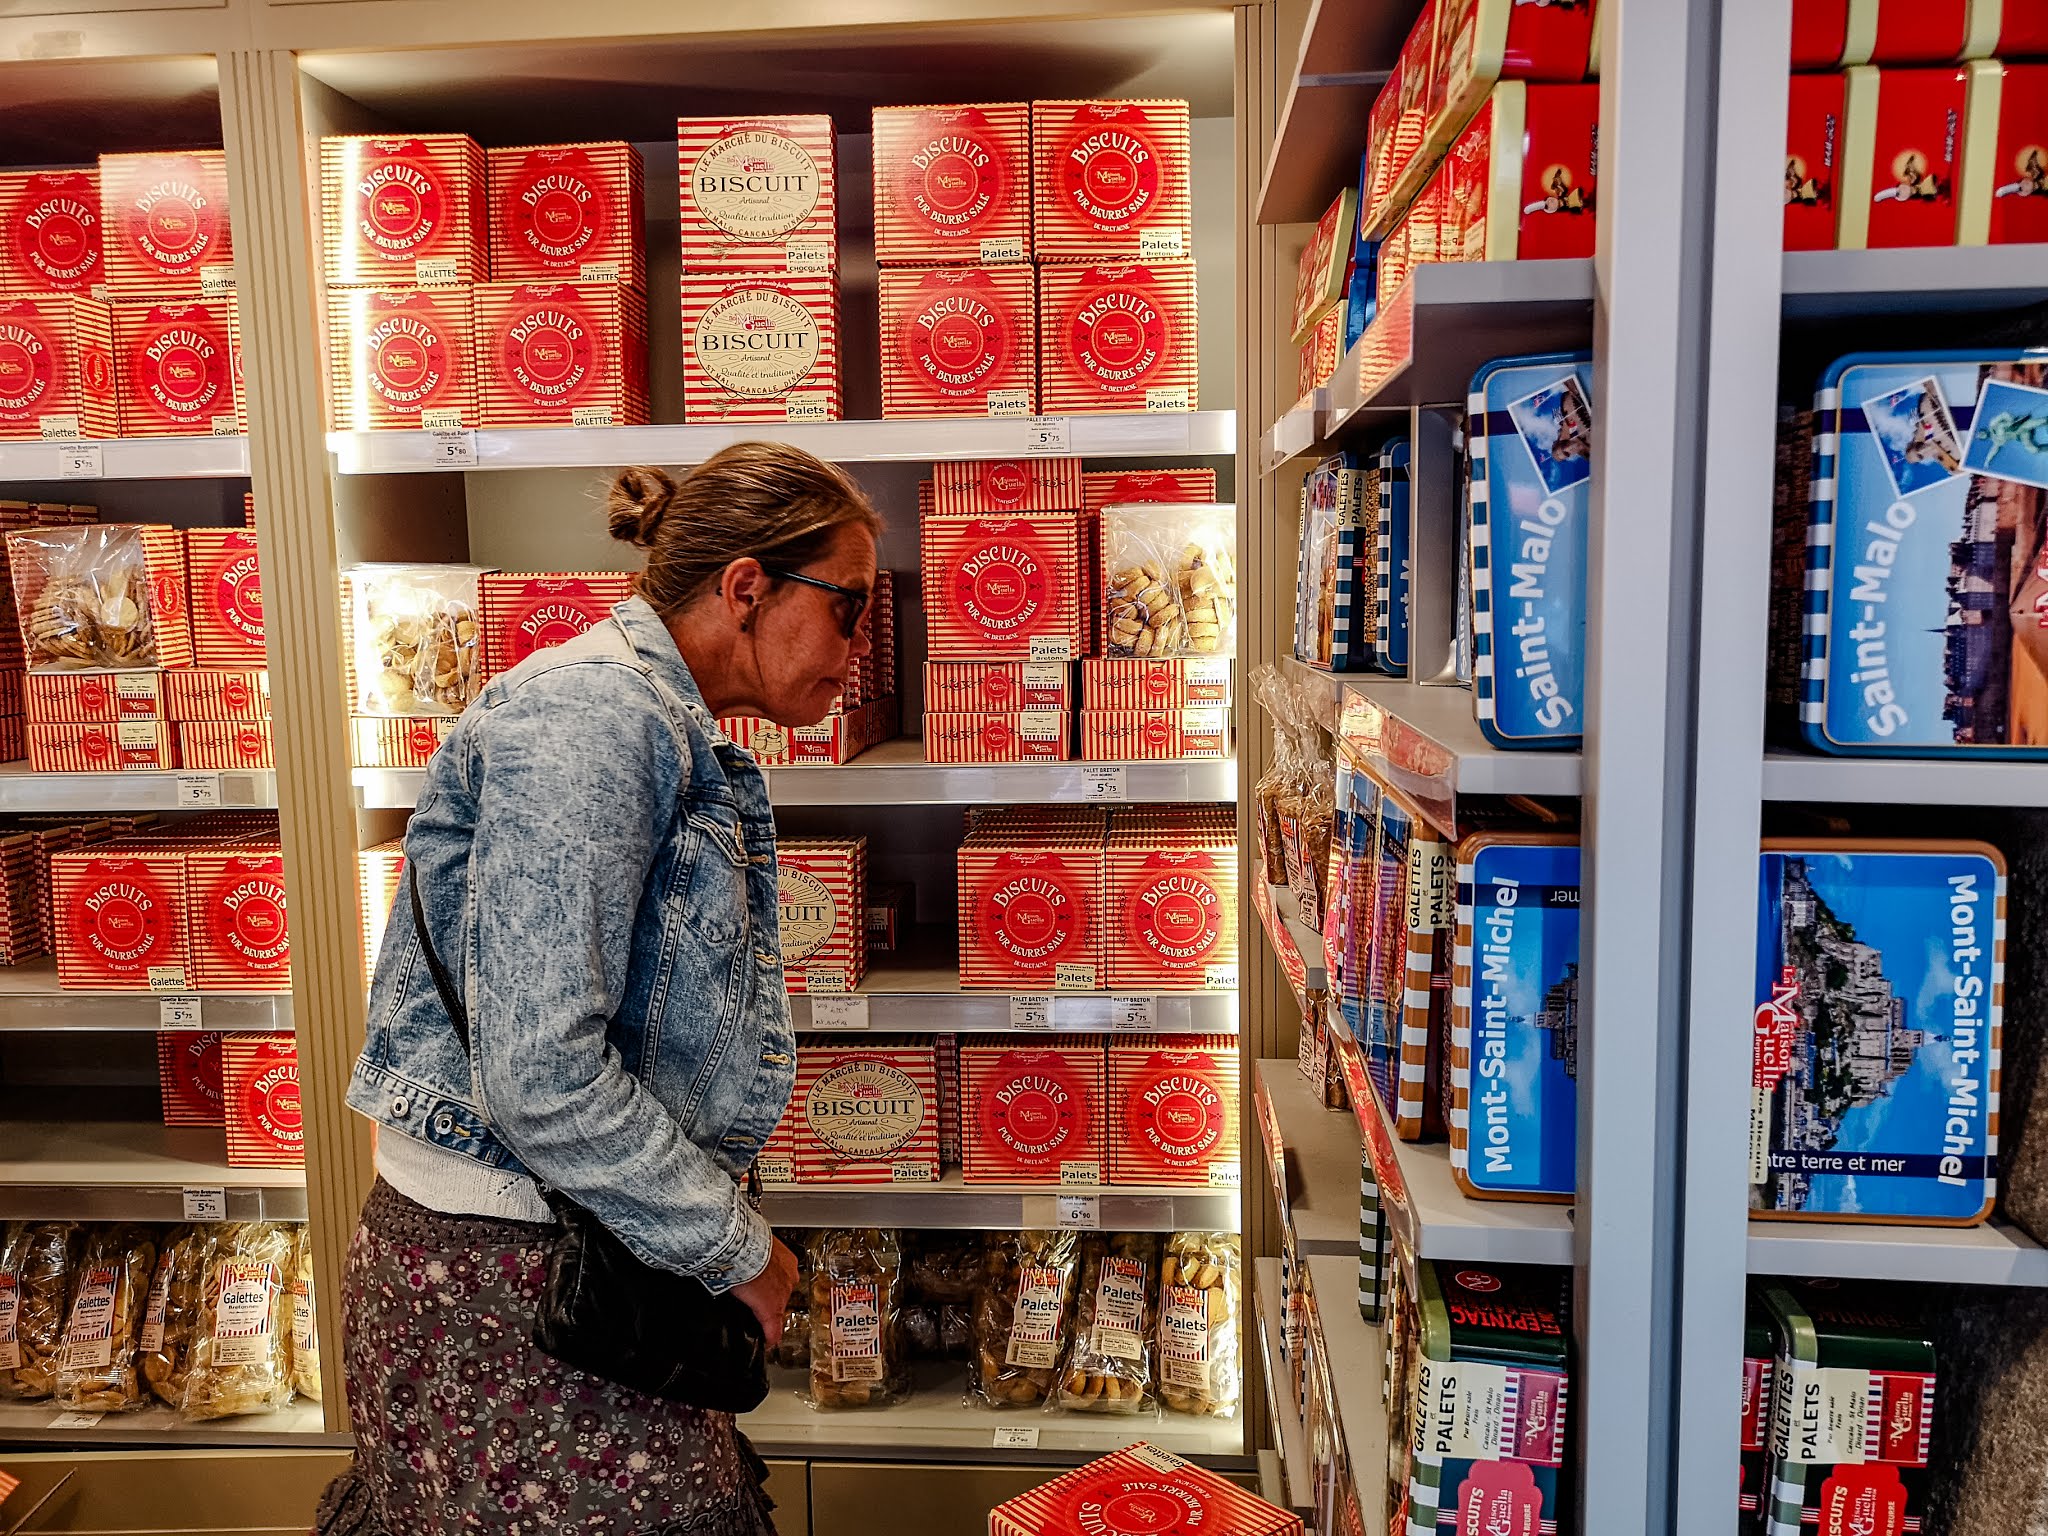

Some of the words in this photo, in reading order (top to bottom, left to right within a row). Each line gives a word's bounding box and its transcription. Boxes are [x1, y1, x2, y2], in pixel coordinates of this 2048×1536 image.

[709, 132, 751, 160] MARCHÉ
[755, 134, 767, 143] DU
[771, 136, 812, 171] BISCUIT
[912, 137, 989, 170] BISCUITS
[1071, 132, 1148, 165] BISCUITS
[358, 164, 431, 199] BISCUITS
[521, 175, 592, 206] BISCUITS
[700, 175, 809, 193] BISCUIT
[136, 182, 206, 213] BISCUITS
[739, 196, 770, 205] Artisanal
[1073, 189, 1091, 211] PUR
[1089, 206, 1128, 220] BEURRE
[26, 199, 95, 229] BISCUITS
[712, 215, 734, 232] MALO
[739, 228, 778, 237] CANCALE
[783, 208, 809, 231] DINARD
[749, 212, 757, 221] et
[759, 211, 794, 221] tradition
[524, 229, 540, 248] PUR
[539, 244, 576, 257] BEURRE
[788, 250, 825, 261] Palets
[982, 248, 1020, 259] Palets
[1142, 240, 1179, 250] Palets
[419, 269, 457, 278] GALETTES
[712, 291, 752, 316] MARCHÉ
[757, 293, 768, 302] DU
[772, 295, 811, 328] BISCUIT
[917, 297, 995, 330] BISCUITS
[1078, 293, 1155, 327] BISCUITS
[368, 318, 437, 350] BISCUITS
[510, 311, 582, 343] BISCUITS
[703, 333, 809, 350] BISCUIT
[147, 330, 214, 362] BISCUITS
[741, 353, 771, 362] Artisanal
[715, 373, 736, 389] MALO
[741, 386, 779, 394] CANCALE
[784, 365, 809, 388] DINARD
[750, 370, 759, 378] et
[760, 369, 795, 378] tradition
[1081, 350, 1099, 370] PUR
[1096, 366, 1136, 380] BEURRE
[513, 365, 531, 386] PUR
[529, 381, 566, 395] BEURRE
[151, 383, 168, 403] PUR
[167, 398, 201, 412] BEURRE
[788, 405, 824, 415] Palets
[989, 399, 1026, 409] Palets
[1148, 399, 1185, 409] Palets
[42, 428, 76, 438] Galettes
[424, 419, 462, 428] GALETTES
[574, 417, 613, 426] GALETTES
[1338, 473, 1349, 526] GALETTES
[1351, 477, 1363, 524] PALETS
[961, 546, 1037, 577] BISCUITS
[521, 605, 594, 636] BISCUITS
[964, 601, 981, 621] PUR
[980, 616, 1018, 630] BEURRE
[1510, 499, 1573, 728] Saint-Malo
[1849, 501, 1916, 738] Saint-Malo
[1031, 645, 1068, 655] Palets
[84, 883, 153, 912] BISCUITS
[791, 869, 829, 903] BISCUIT
[992, 877, 1065, 908] BISCUITS
[1141, 876, 1217, 907] BISCUITS
[1410, 849, 1421, 928] GALETTES
[1430, 855, 1444, 924] PALETS
[88, 934, 104, 952] PUR
[103, 947, 138, 961] BEURRE
[995, 929, 1012, 949] PUR
[1010, 944, 1047, 957] BEURRE
[151, 977, 185, 988] Galettes
[808, 975, 843, 986] Palets
[1057, 973, 1093, 983] Palets
[1206, 975, 1236, 985] Palet
[1478, 877, 1520, 1174] Mont-Saint-Michel
[1938, 874, 1983, 1187] Mont-Saint-Michel
[821, 1063, 861, 1087] MARCHÉ
[864, 1064, 876, 1073] DU
[879, 1065, 917, 1097] BISCUIT
[996, 1076, 1067, 1105] BISCUITS
[1143, 1076, 1217, 1106] BISCUITS
[813, 1101, 914, 1116] BISCUIT
[849, 1118, 878, 1127] Artisanal
[849, 1146, 885, 1155] CANCALE
[889, 1127, 914, 1148] DINARD
[868, 1131, 900, 1140] tradition
[1145, 1128, 1163, 1147] PUR
[1160, 1143, 1198, 1156] BEURRE
[895, 1167, 929, 1178] Palets
[1062, 1170, 1097, 1180] Palets
[1210, 1171, 1240, 1181] Palet
[1802, 1155, 1842, 1169] terre
[1849, 1157, 1865, 1171] et
[1872, 1159, 1905, 1172] mer
[78, 1294, 110, 1310] Galettes
[223, 1292, 263, 1304] Galettes
[1021, 1299, 1059, 1311] Palets
[1103, 1286, 1143, 1301] Palets
[836, 1315, 878, 1327] Palets
[1165, 1316, 1206, 1331] Palets
[1414, 1363, 1431, 1451] GALETTES
[1436, 1376, 1456, 1453] PALETS
[1774, 1369, 1794, 1460] GALETTES
[1801, 1383, 1820, 1459] PALETS
[1144, 1445, 1185, 1468] Galettes
[1466, 1487, 1484, 1536] SCUITS
[1829, 1486, 1848, 1536] ISCUITS
